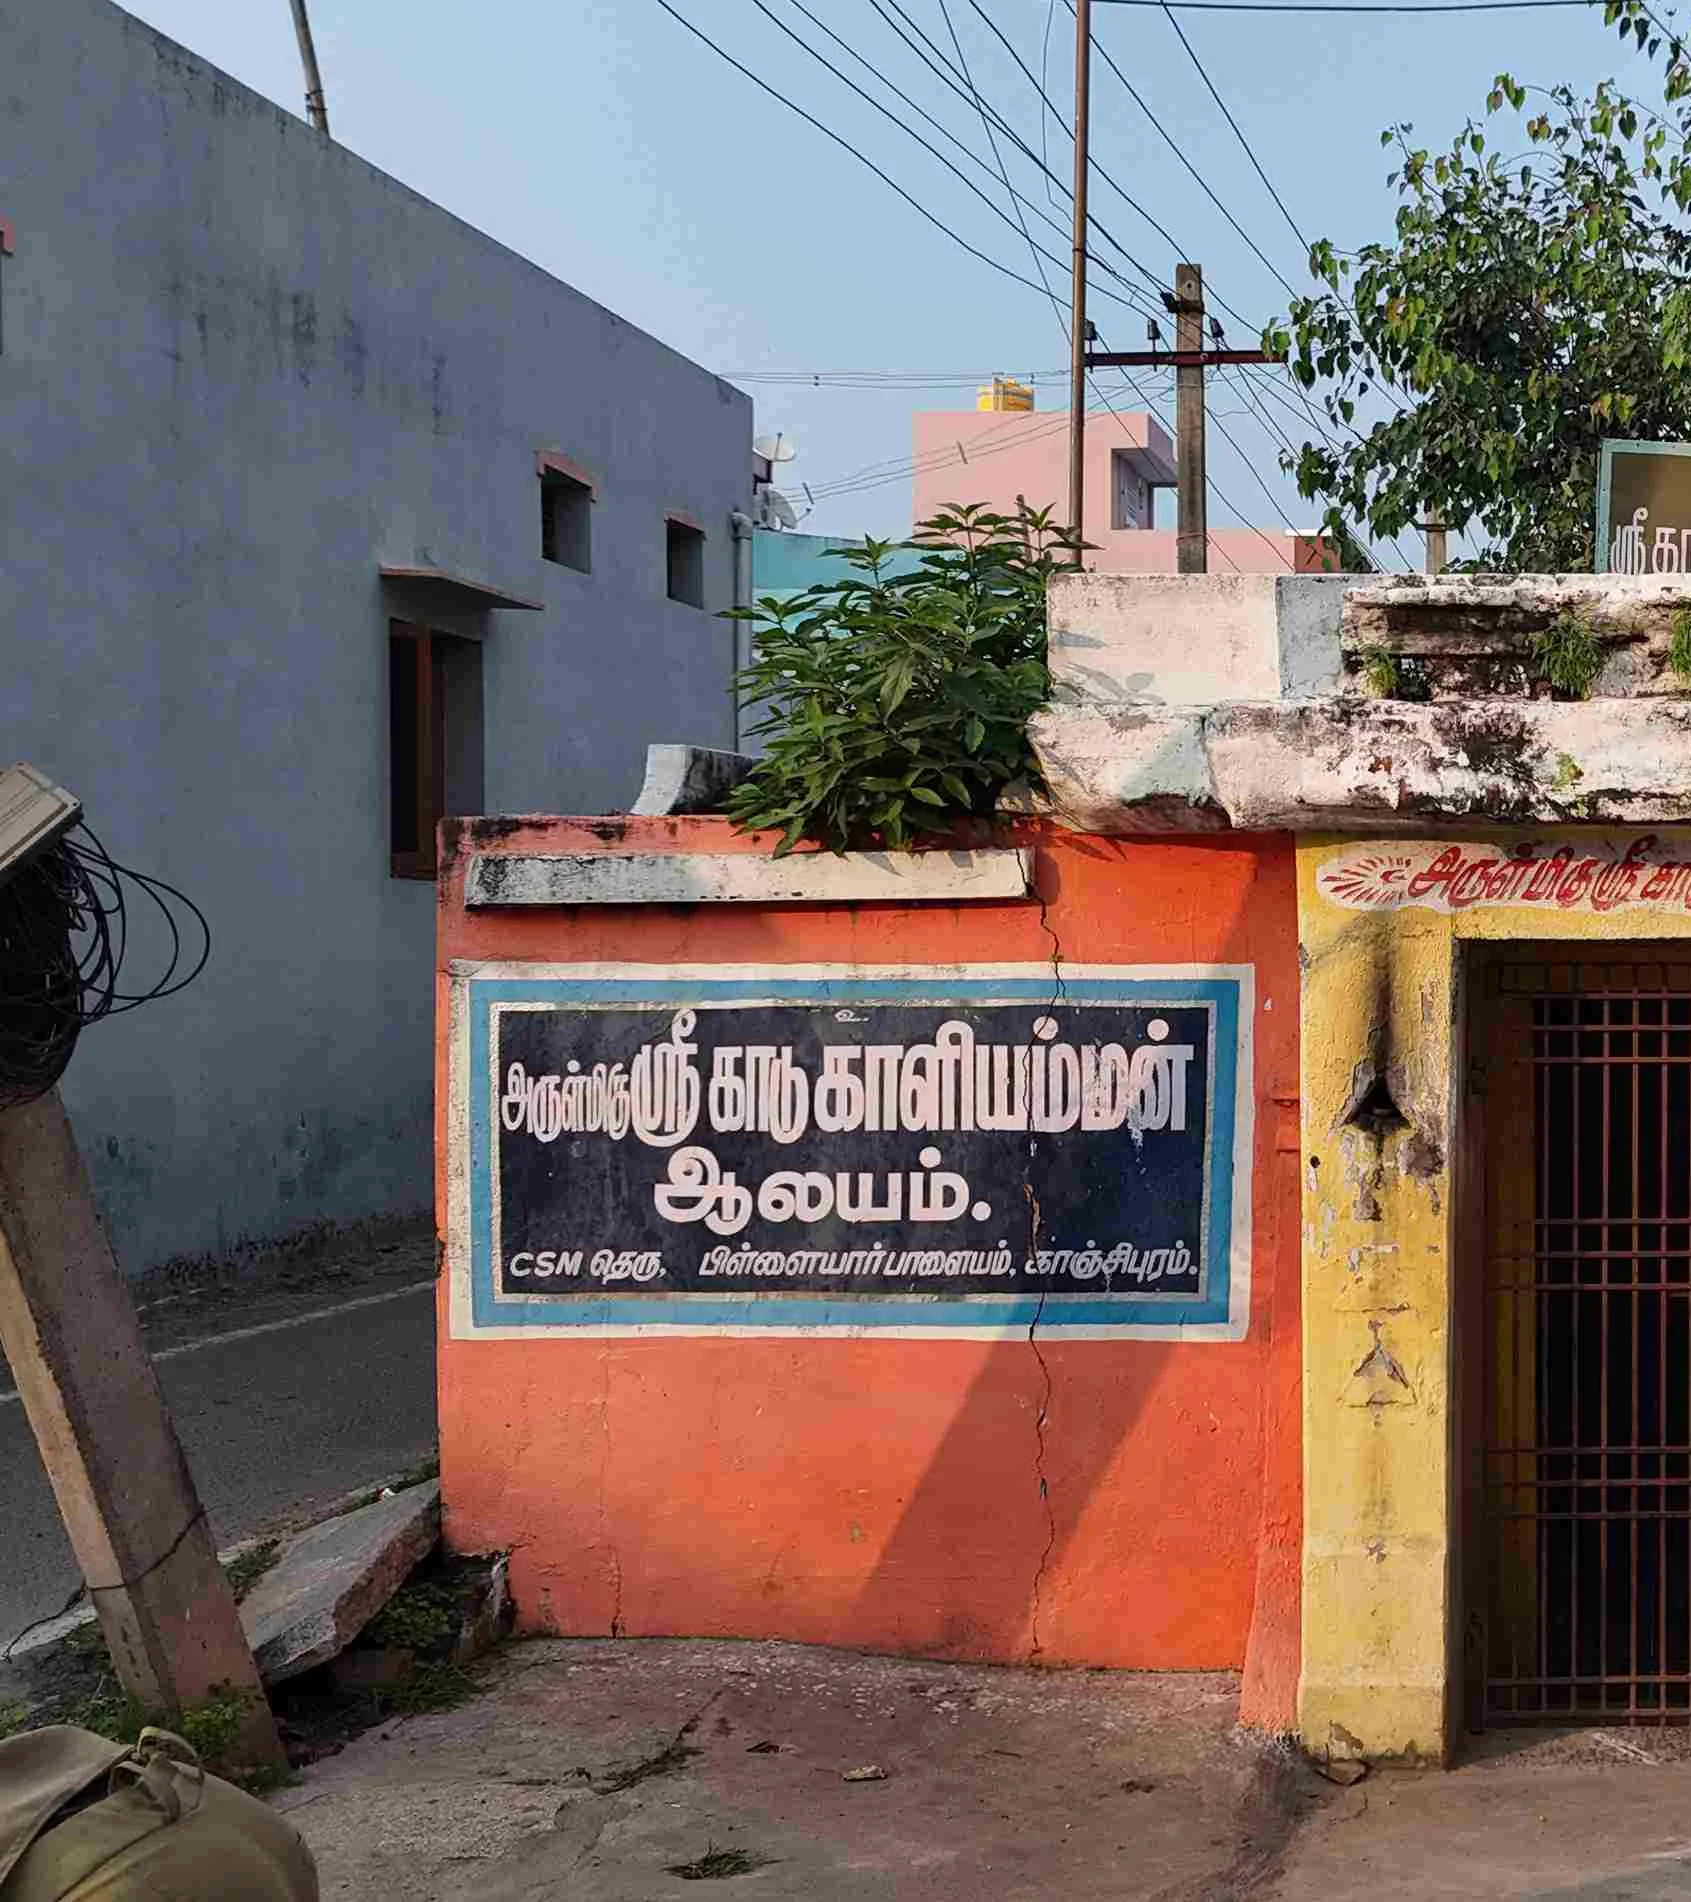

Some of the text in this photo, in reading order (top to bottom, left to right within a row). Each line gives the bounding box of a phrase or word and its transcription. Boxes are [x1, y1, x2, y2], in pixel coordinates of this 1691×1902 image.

[814, 1016, 1194, 1133] காளியம்மன்
[654, 1146, 992, 1235] ஆலயம்.
[509, 1251, 583, 1277] CSM
